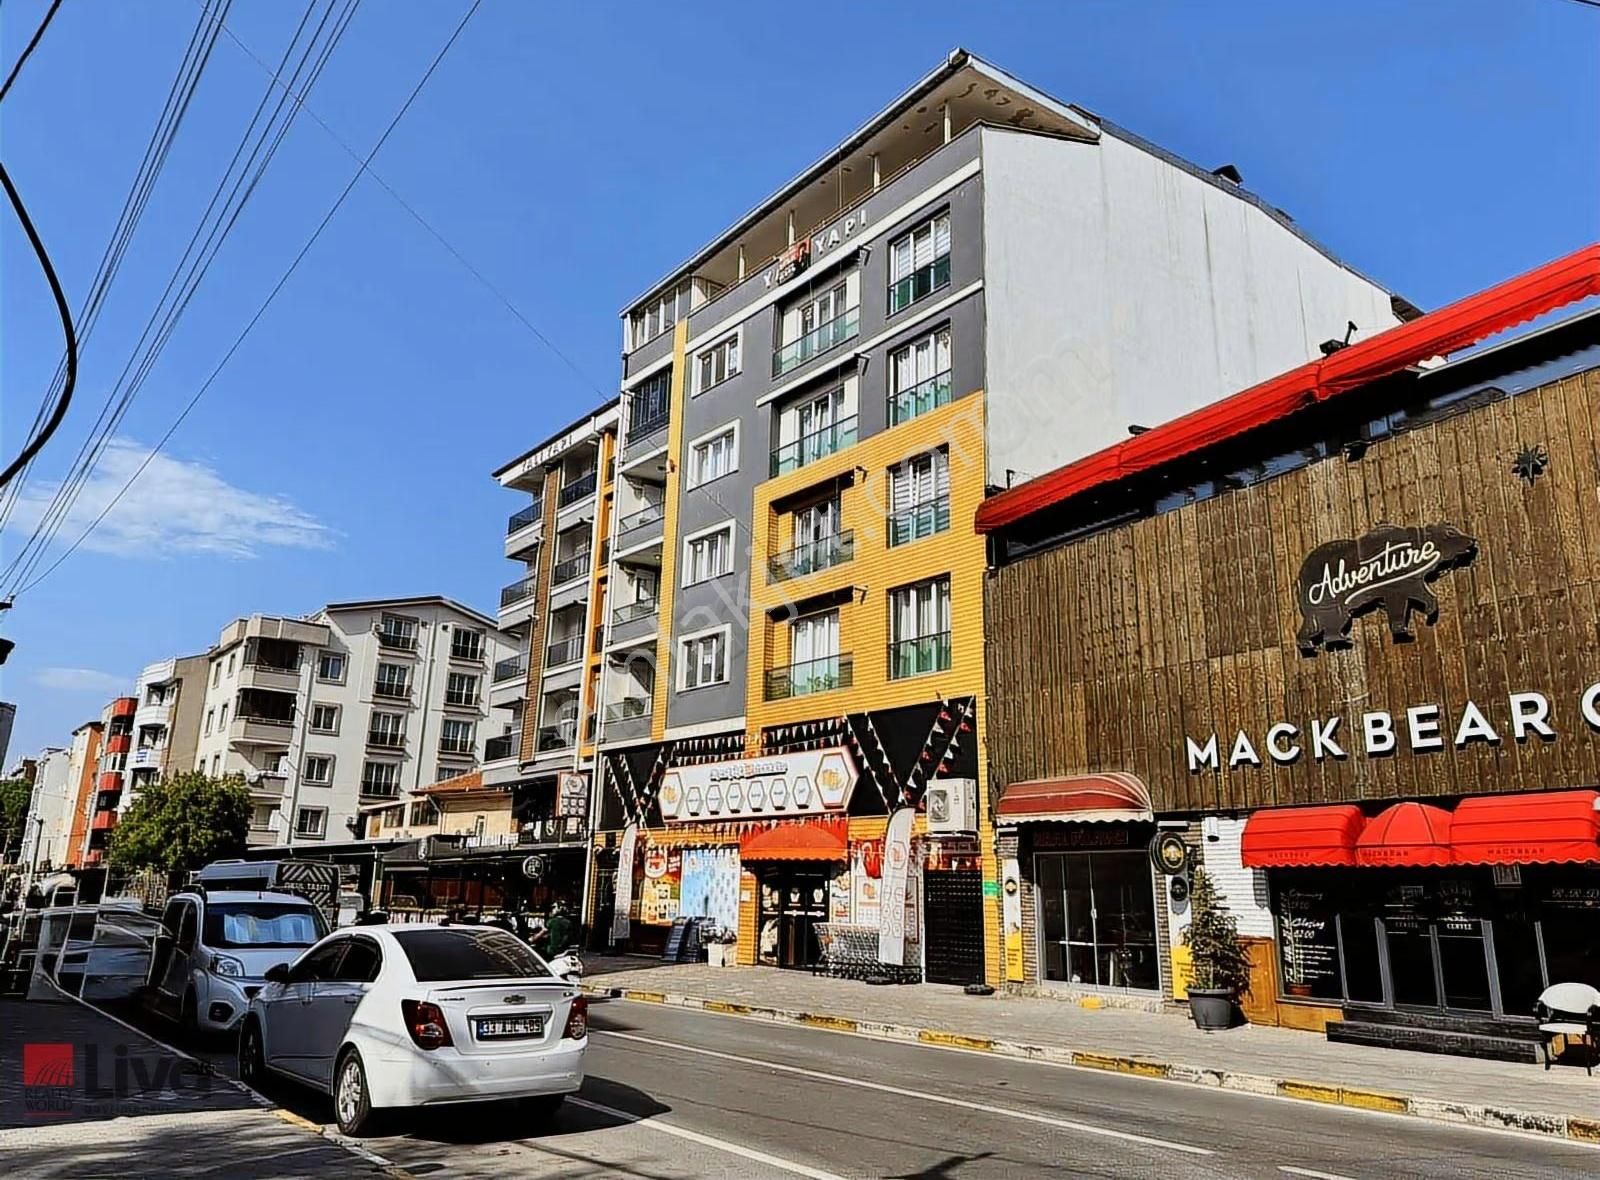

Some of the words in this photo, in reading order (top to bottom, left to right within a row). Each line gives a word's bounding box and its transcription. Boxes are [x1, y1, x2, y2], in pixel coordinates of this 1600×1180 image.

[814, 210, 867, 254] YAPI
[1308, 540, 1442, 605] Adventure
[1187, 691, 1555, 770] MACKBEAR
